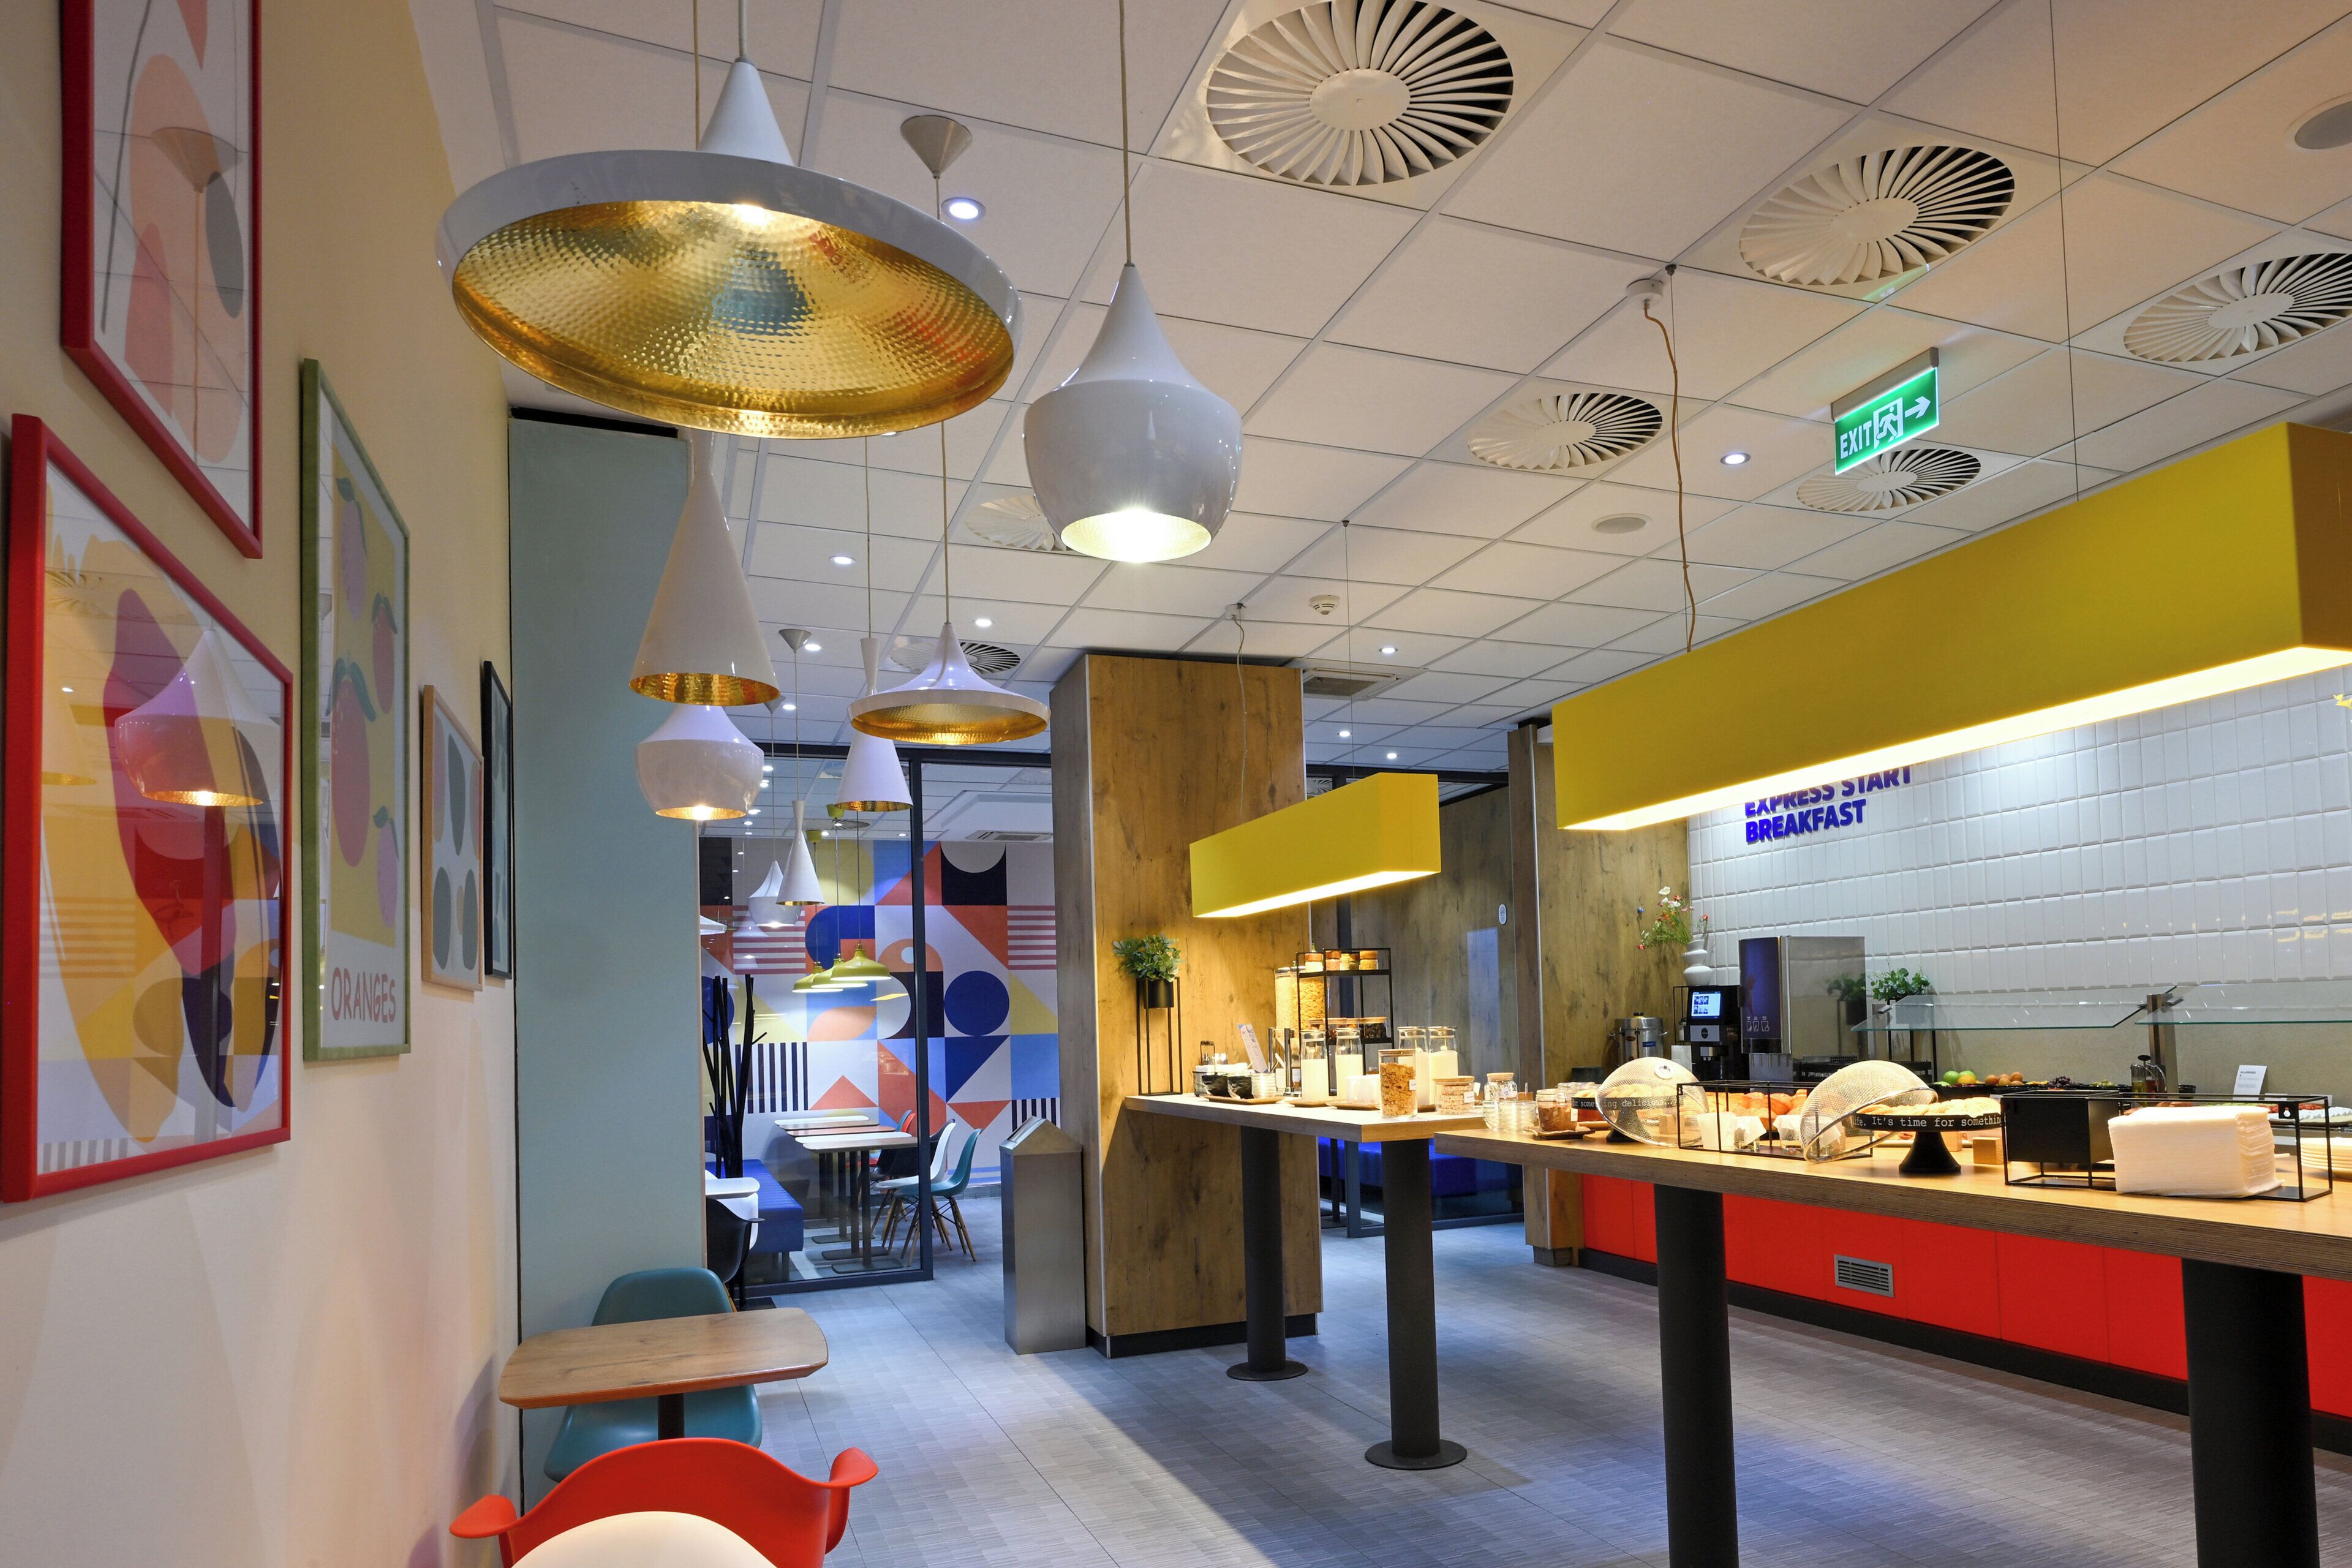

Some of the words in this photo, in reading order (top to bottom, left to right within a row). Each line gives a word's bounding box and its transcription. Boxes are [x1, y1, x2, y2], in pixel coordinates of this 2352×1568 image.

[1840, 420, 1872, 459] EXIT
[1745, 783, 1835, 817] EXPRESS
[1841, 766, 1910, 797] START
[1746, 799, 1866, 843] BREAKFAST
[331, 967, 396, 1023] ORANGES
[1872, 1117, 1894, 1126] It's
[1900, 1117, 1927, 1127] time
[1934, 1117, 1954, 1127] for
